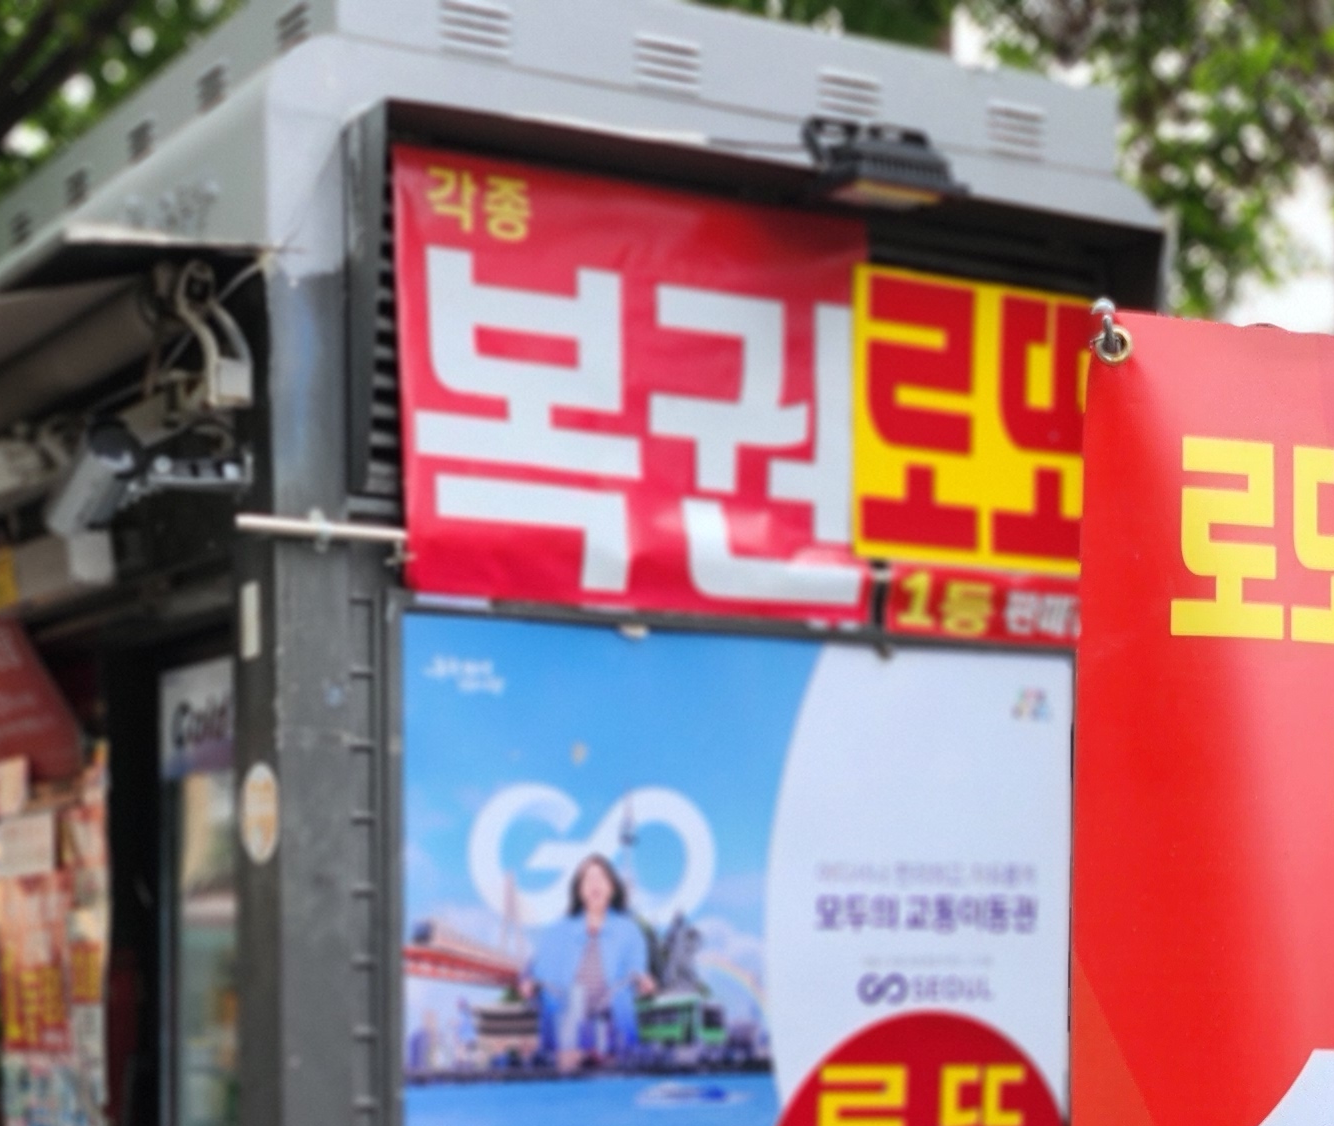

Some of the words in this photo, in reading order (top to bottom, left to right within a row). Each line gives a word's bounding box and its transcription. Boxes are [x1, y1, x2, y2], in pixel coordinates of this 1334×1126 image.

[425, 166, 532, 242] 각종
[413, 244, 864, 604] 복권
[860, 272, 1080, 562] 로또
[896, 570, 994, 637] 1등
[1004, 589, 1081, 639] 판매
